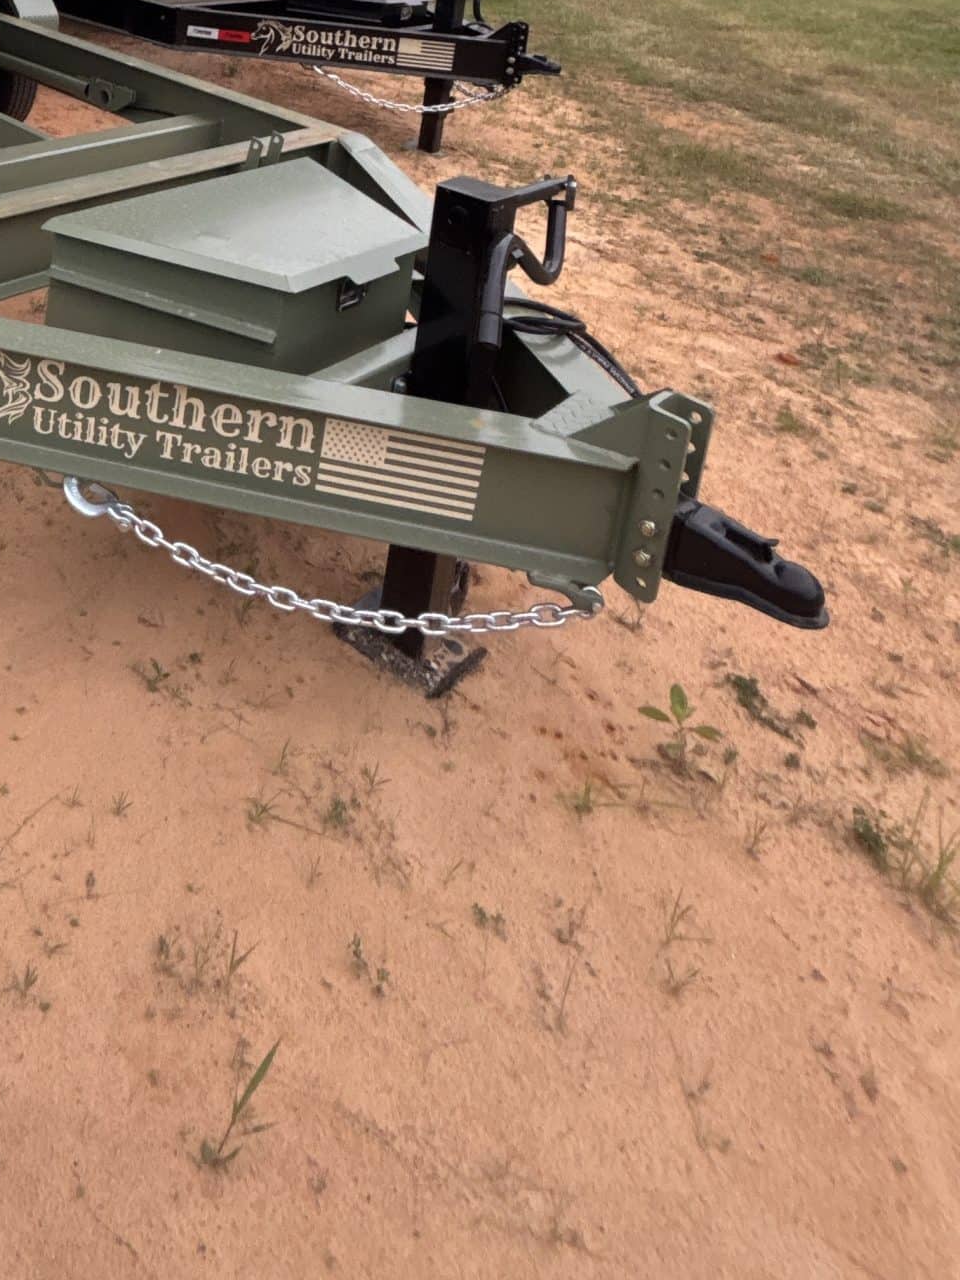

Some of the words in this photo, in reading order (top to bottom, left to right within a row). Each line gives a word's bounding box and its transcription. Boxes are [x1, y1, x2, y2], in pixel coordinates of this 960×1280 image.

[292, 25, 397, 52] Southern
[292, 43, 335, 60] Utility
[338, 47, 396, 65] Trailers
[34, 359, 315, 454] Southern
[32, 406, 148, 459] Utility
[155, 429, 312, 487] Trailers
